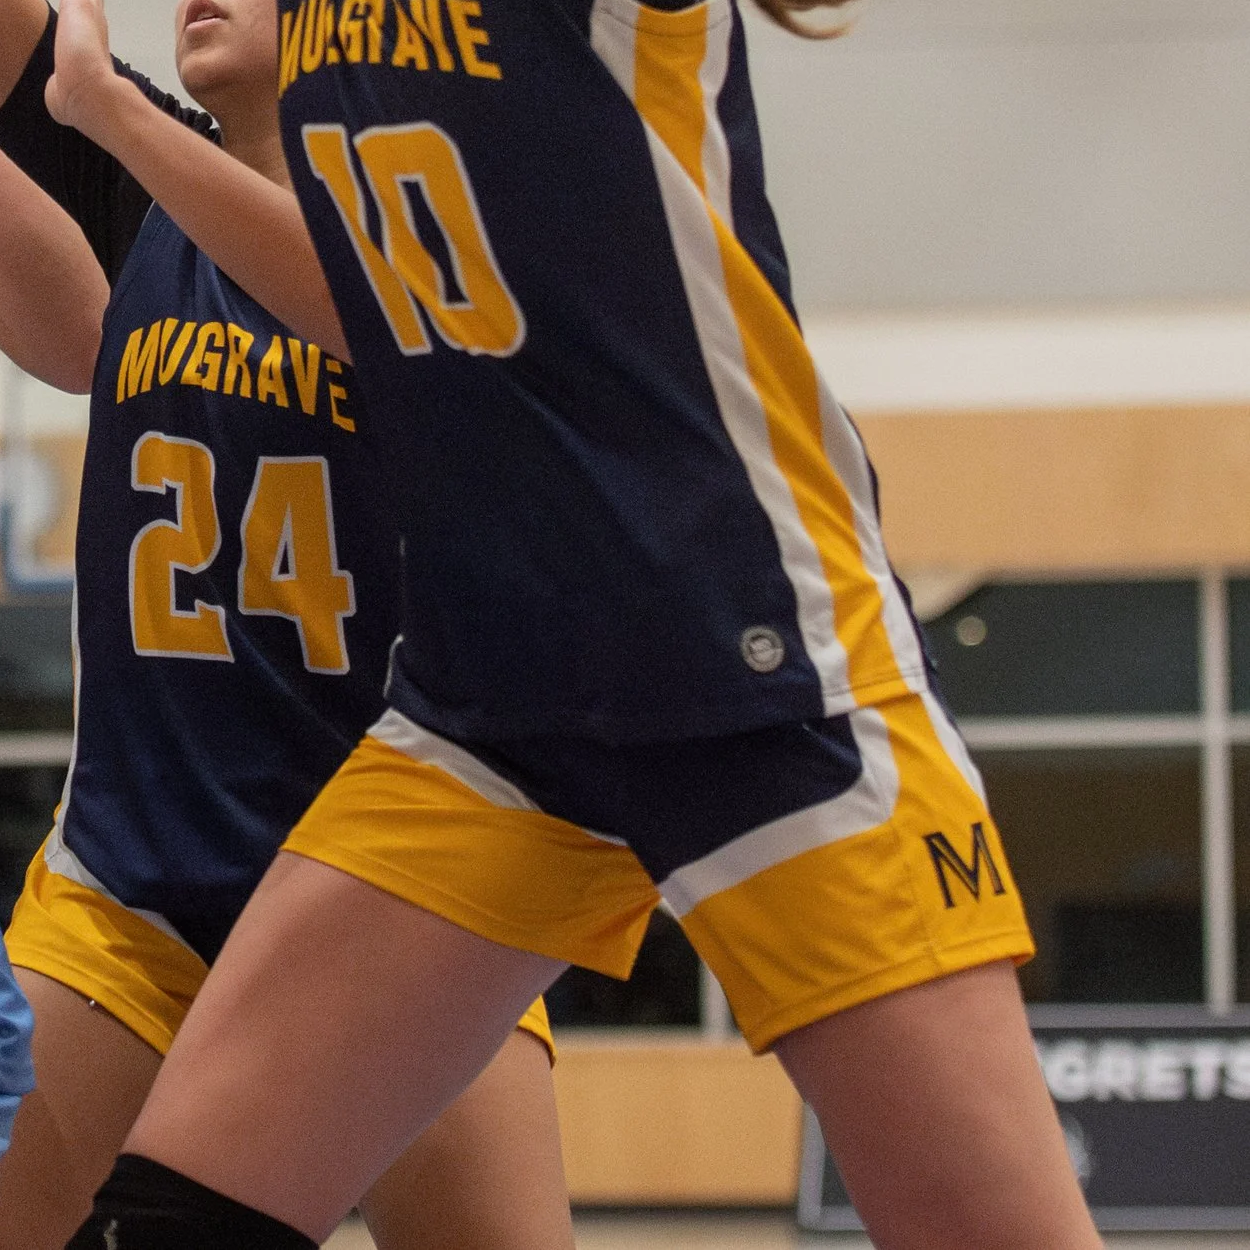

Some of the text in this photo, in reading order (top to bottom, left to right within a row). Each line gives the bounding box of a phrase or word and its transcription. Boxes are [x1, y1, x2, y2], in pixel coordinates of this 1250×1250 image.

[301, 121, 527, 358] 10
[128, 430, 357, 675] 24
[921, 821, 1007, 910] M
[1034, 1036, 1250, 1101] GRETS
